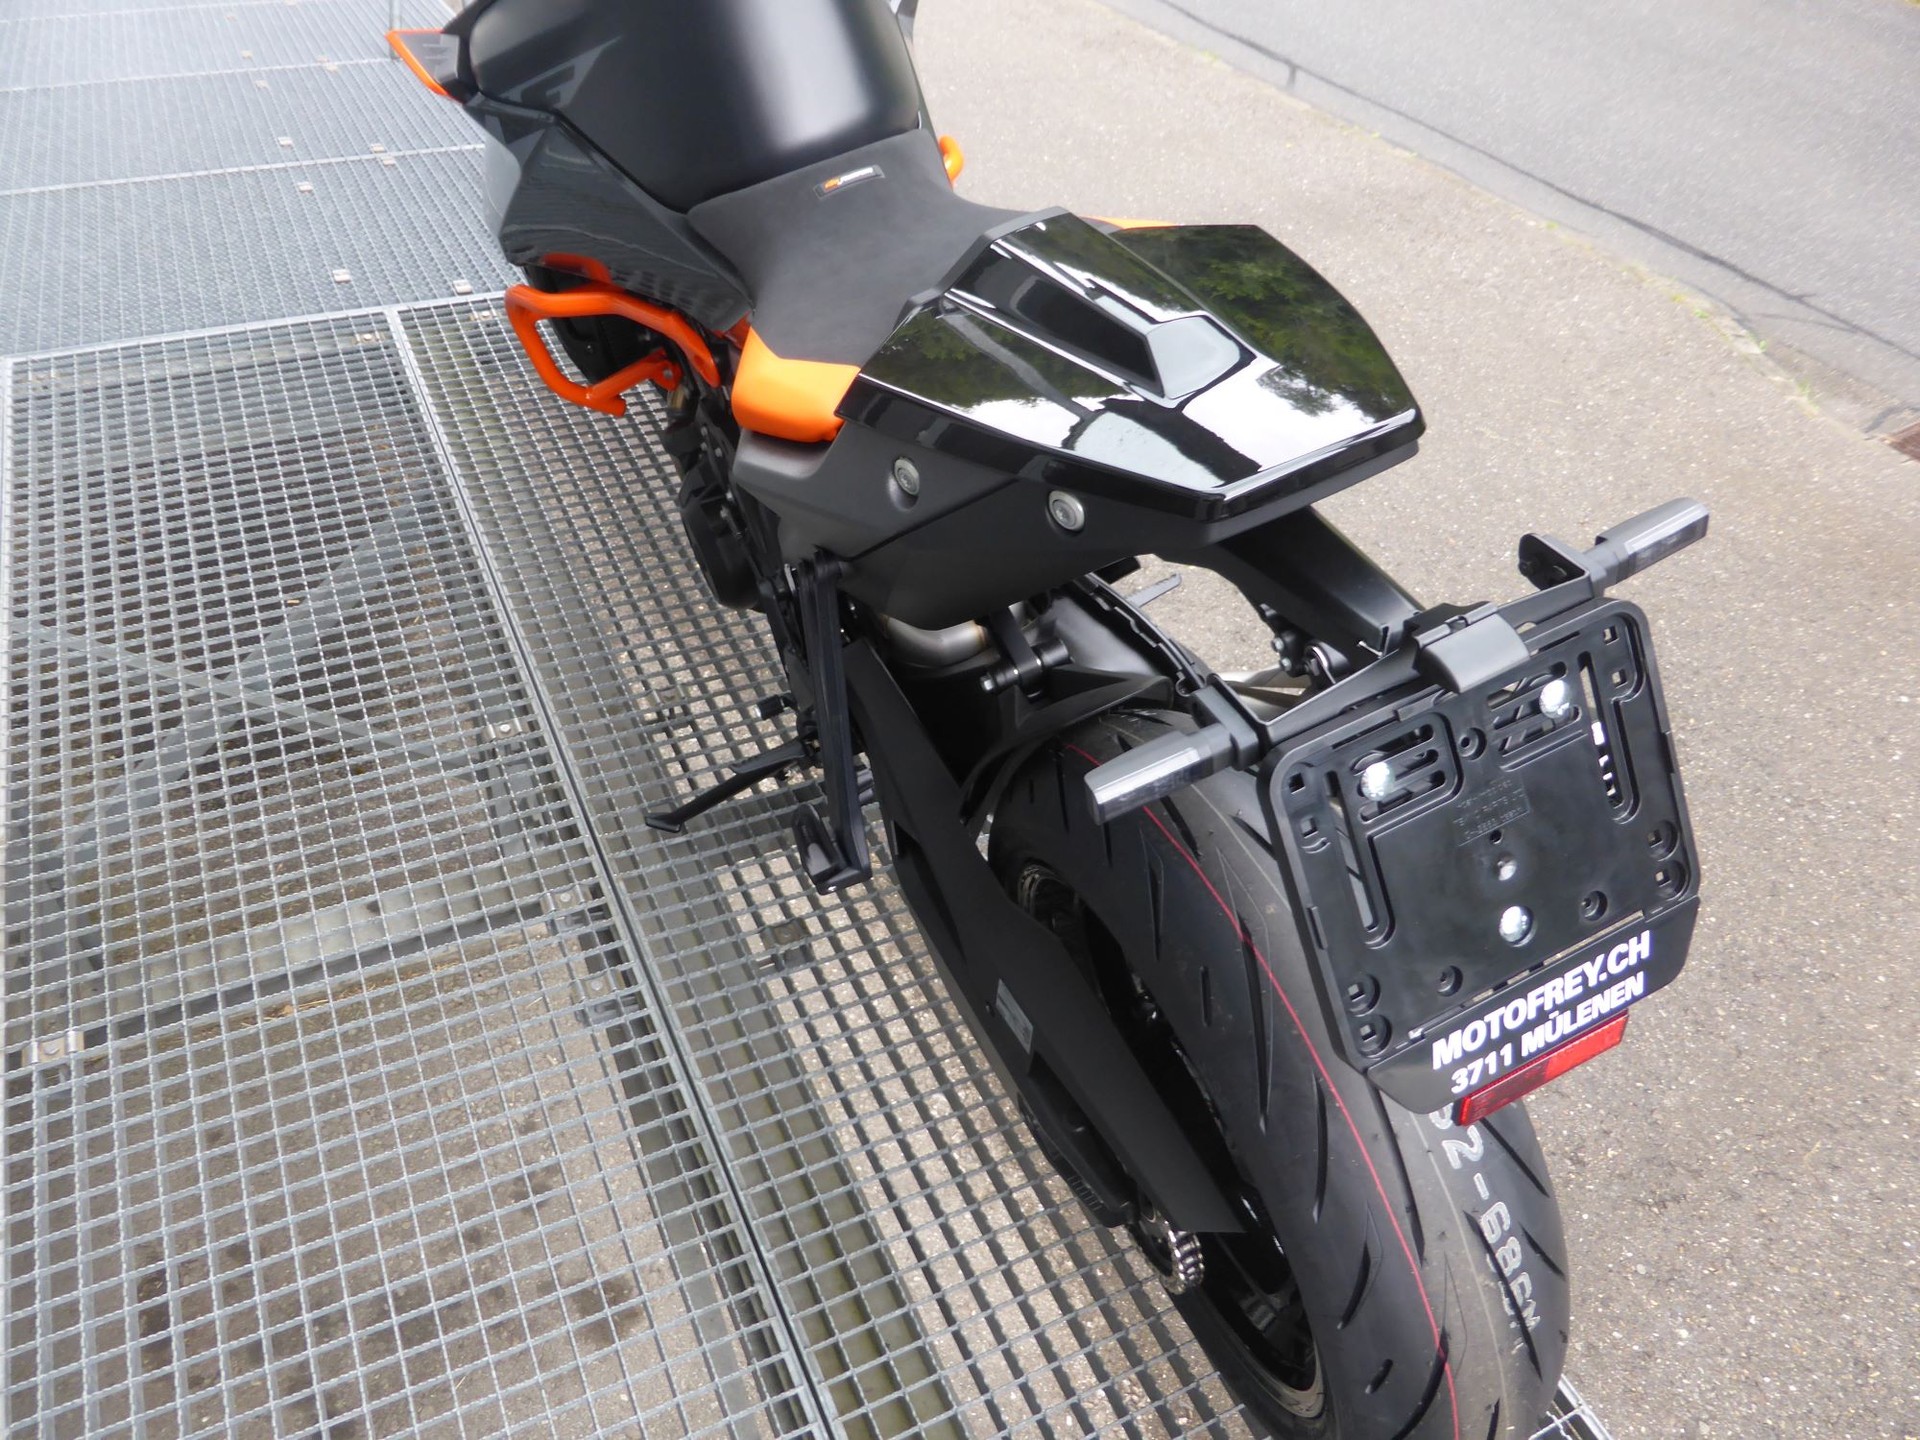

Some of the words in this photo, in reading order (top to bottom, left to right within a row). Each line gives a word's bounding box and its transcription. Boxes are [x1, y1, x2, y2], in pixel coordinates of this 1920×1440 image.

[1432, 930, 1650, 1070] MOTOFREY.CH
[1451, 1043, 1513, 1095] 3711
[1520, 971, 1645, 1057] MÜLENEN
